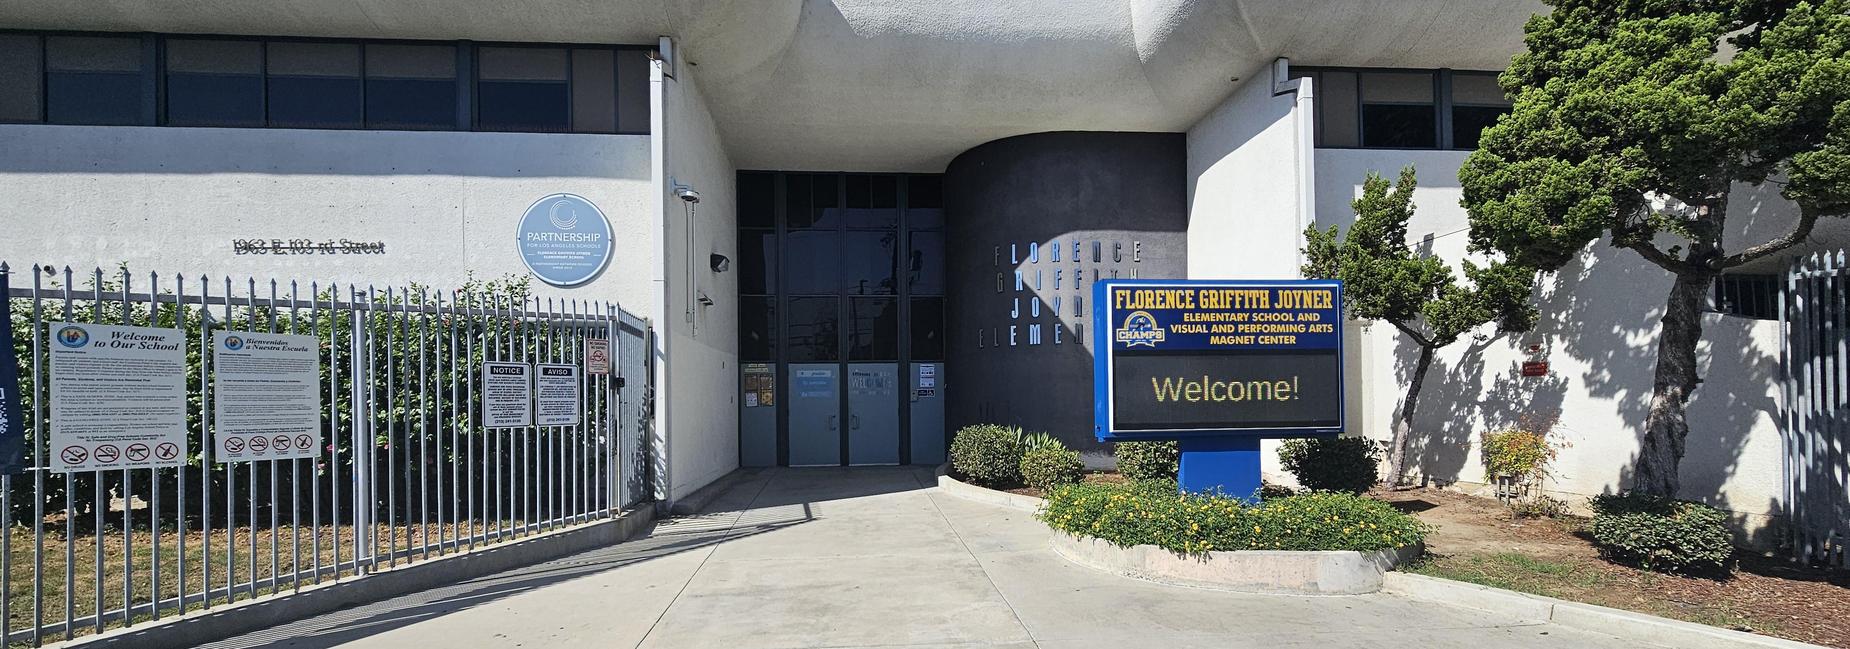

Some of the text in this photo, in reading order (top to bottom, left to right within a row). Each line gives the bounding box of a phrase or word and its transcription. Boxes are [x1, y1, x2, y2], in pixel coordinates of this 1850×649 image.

[527, 232, 601, 242] PARTNERSHIP
[232, 239, 266, 253] 1963
[288, 239, 314, 253] 103
[317, 239, 335, 253] rd
[340, 238, 384, 254] Street
[995, 240, 1140, 266] FLORENCE
[1115, 290, 1333, 309] FLORENCE GRIFFITH JOYNER
[1011, 296, 1083, 318] JOYN
[1183, 313, 1320, 322] ELEMENTARY SCHOOL AND
[1170, 324, 1333, 333] VISUAL AND PERFORMING ARTS
[111, 331, 166, 342] Welcome
[979, 323, 1084, 348] ELEMEN
[1118, 330, 1162, 340] CHAMPS
[94, 340, 179, 351] to Our School
[245, 338, 289, 346] Bienvenidos
[1210, 336, 1297, 345] MAGNET CENTER
[252, 344, 280, 352] Nuestra
[493, 367, 521, 375] NOTICE
[547, 368, 568, 376] AVISO
[1151, 375, 1299, 402] Welcome!
